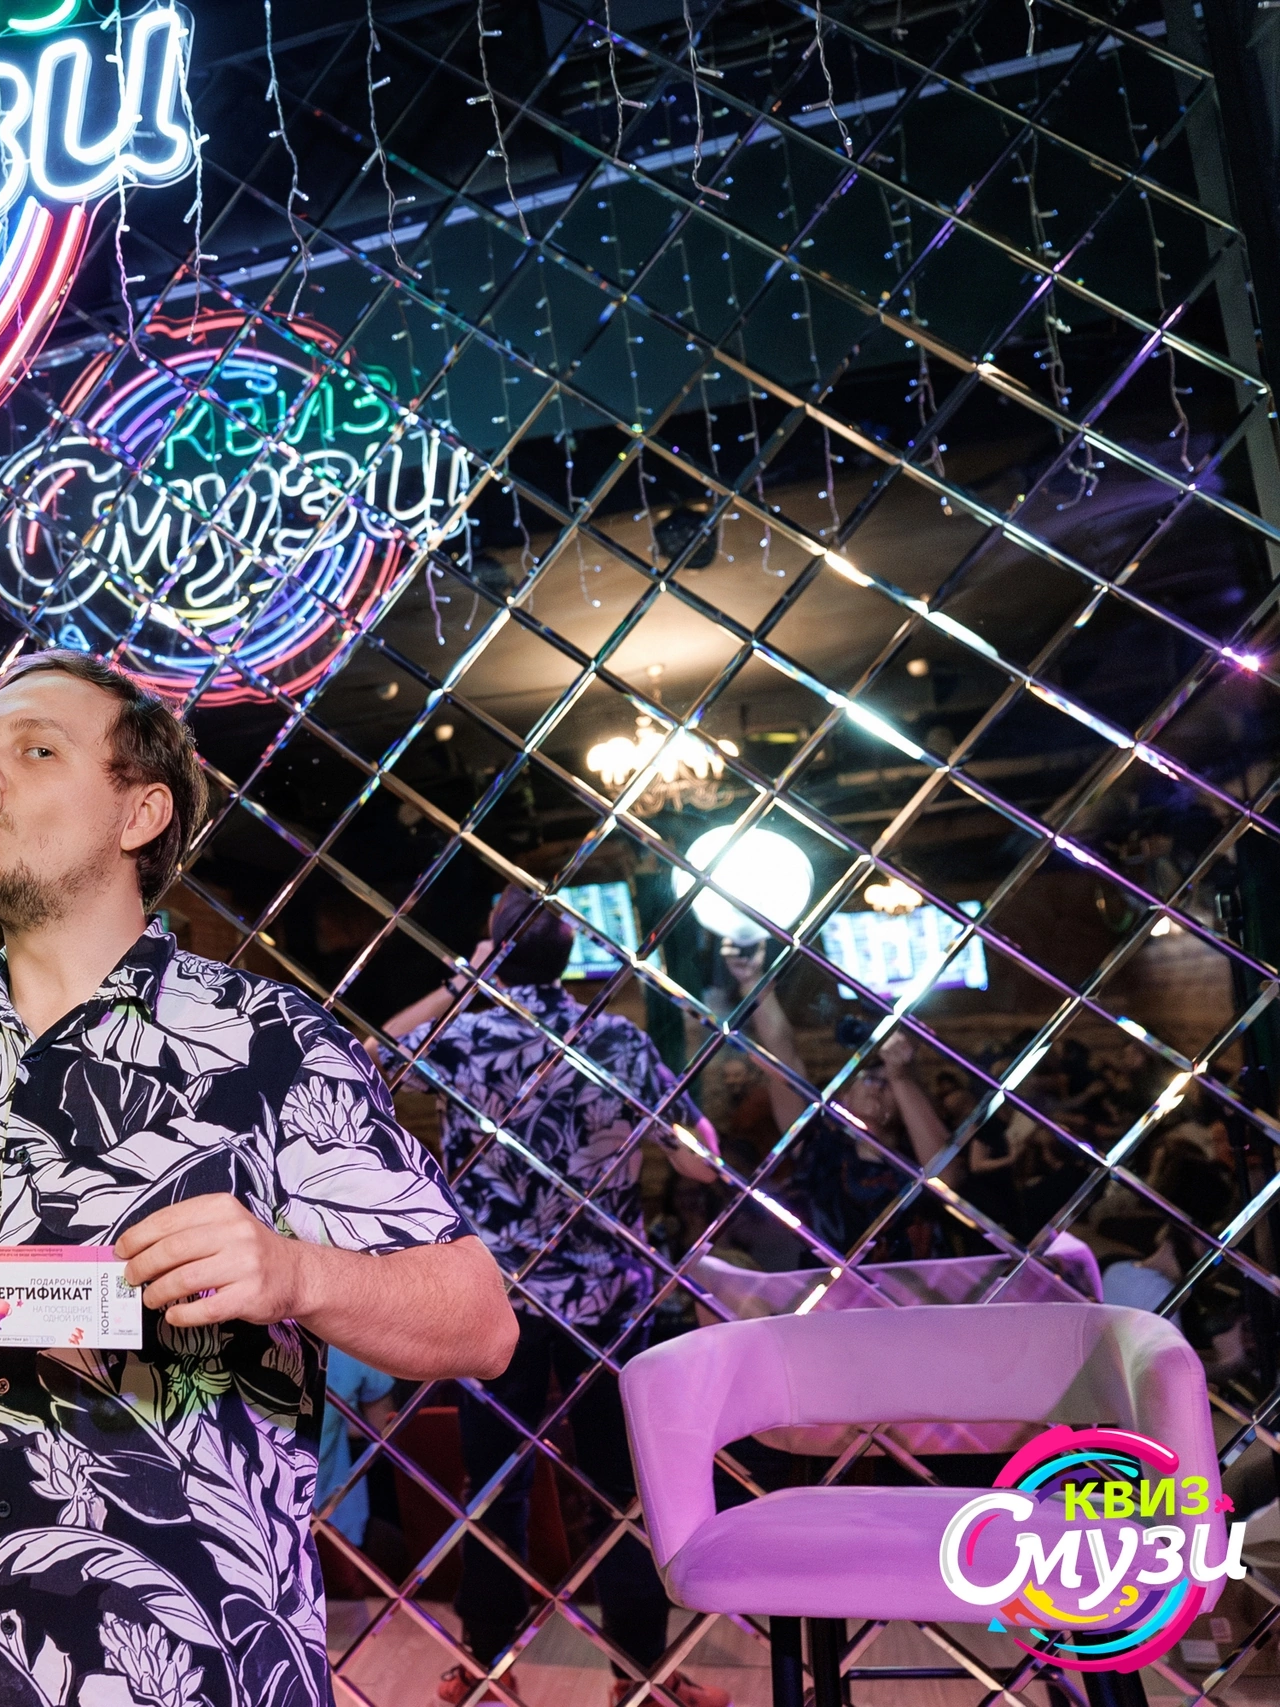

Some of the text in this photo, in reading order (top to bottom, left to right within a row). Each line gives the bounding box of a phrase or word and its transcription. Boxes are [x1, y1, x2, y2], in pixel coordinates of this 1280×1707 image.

[163, 365, 398, 470] КВИЗ
[30, 1276, 92, 1286] ПОДАРОЧНЫЙ
[100, 1272, 110, 1335] КОНТРОЛЬ
